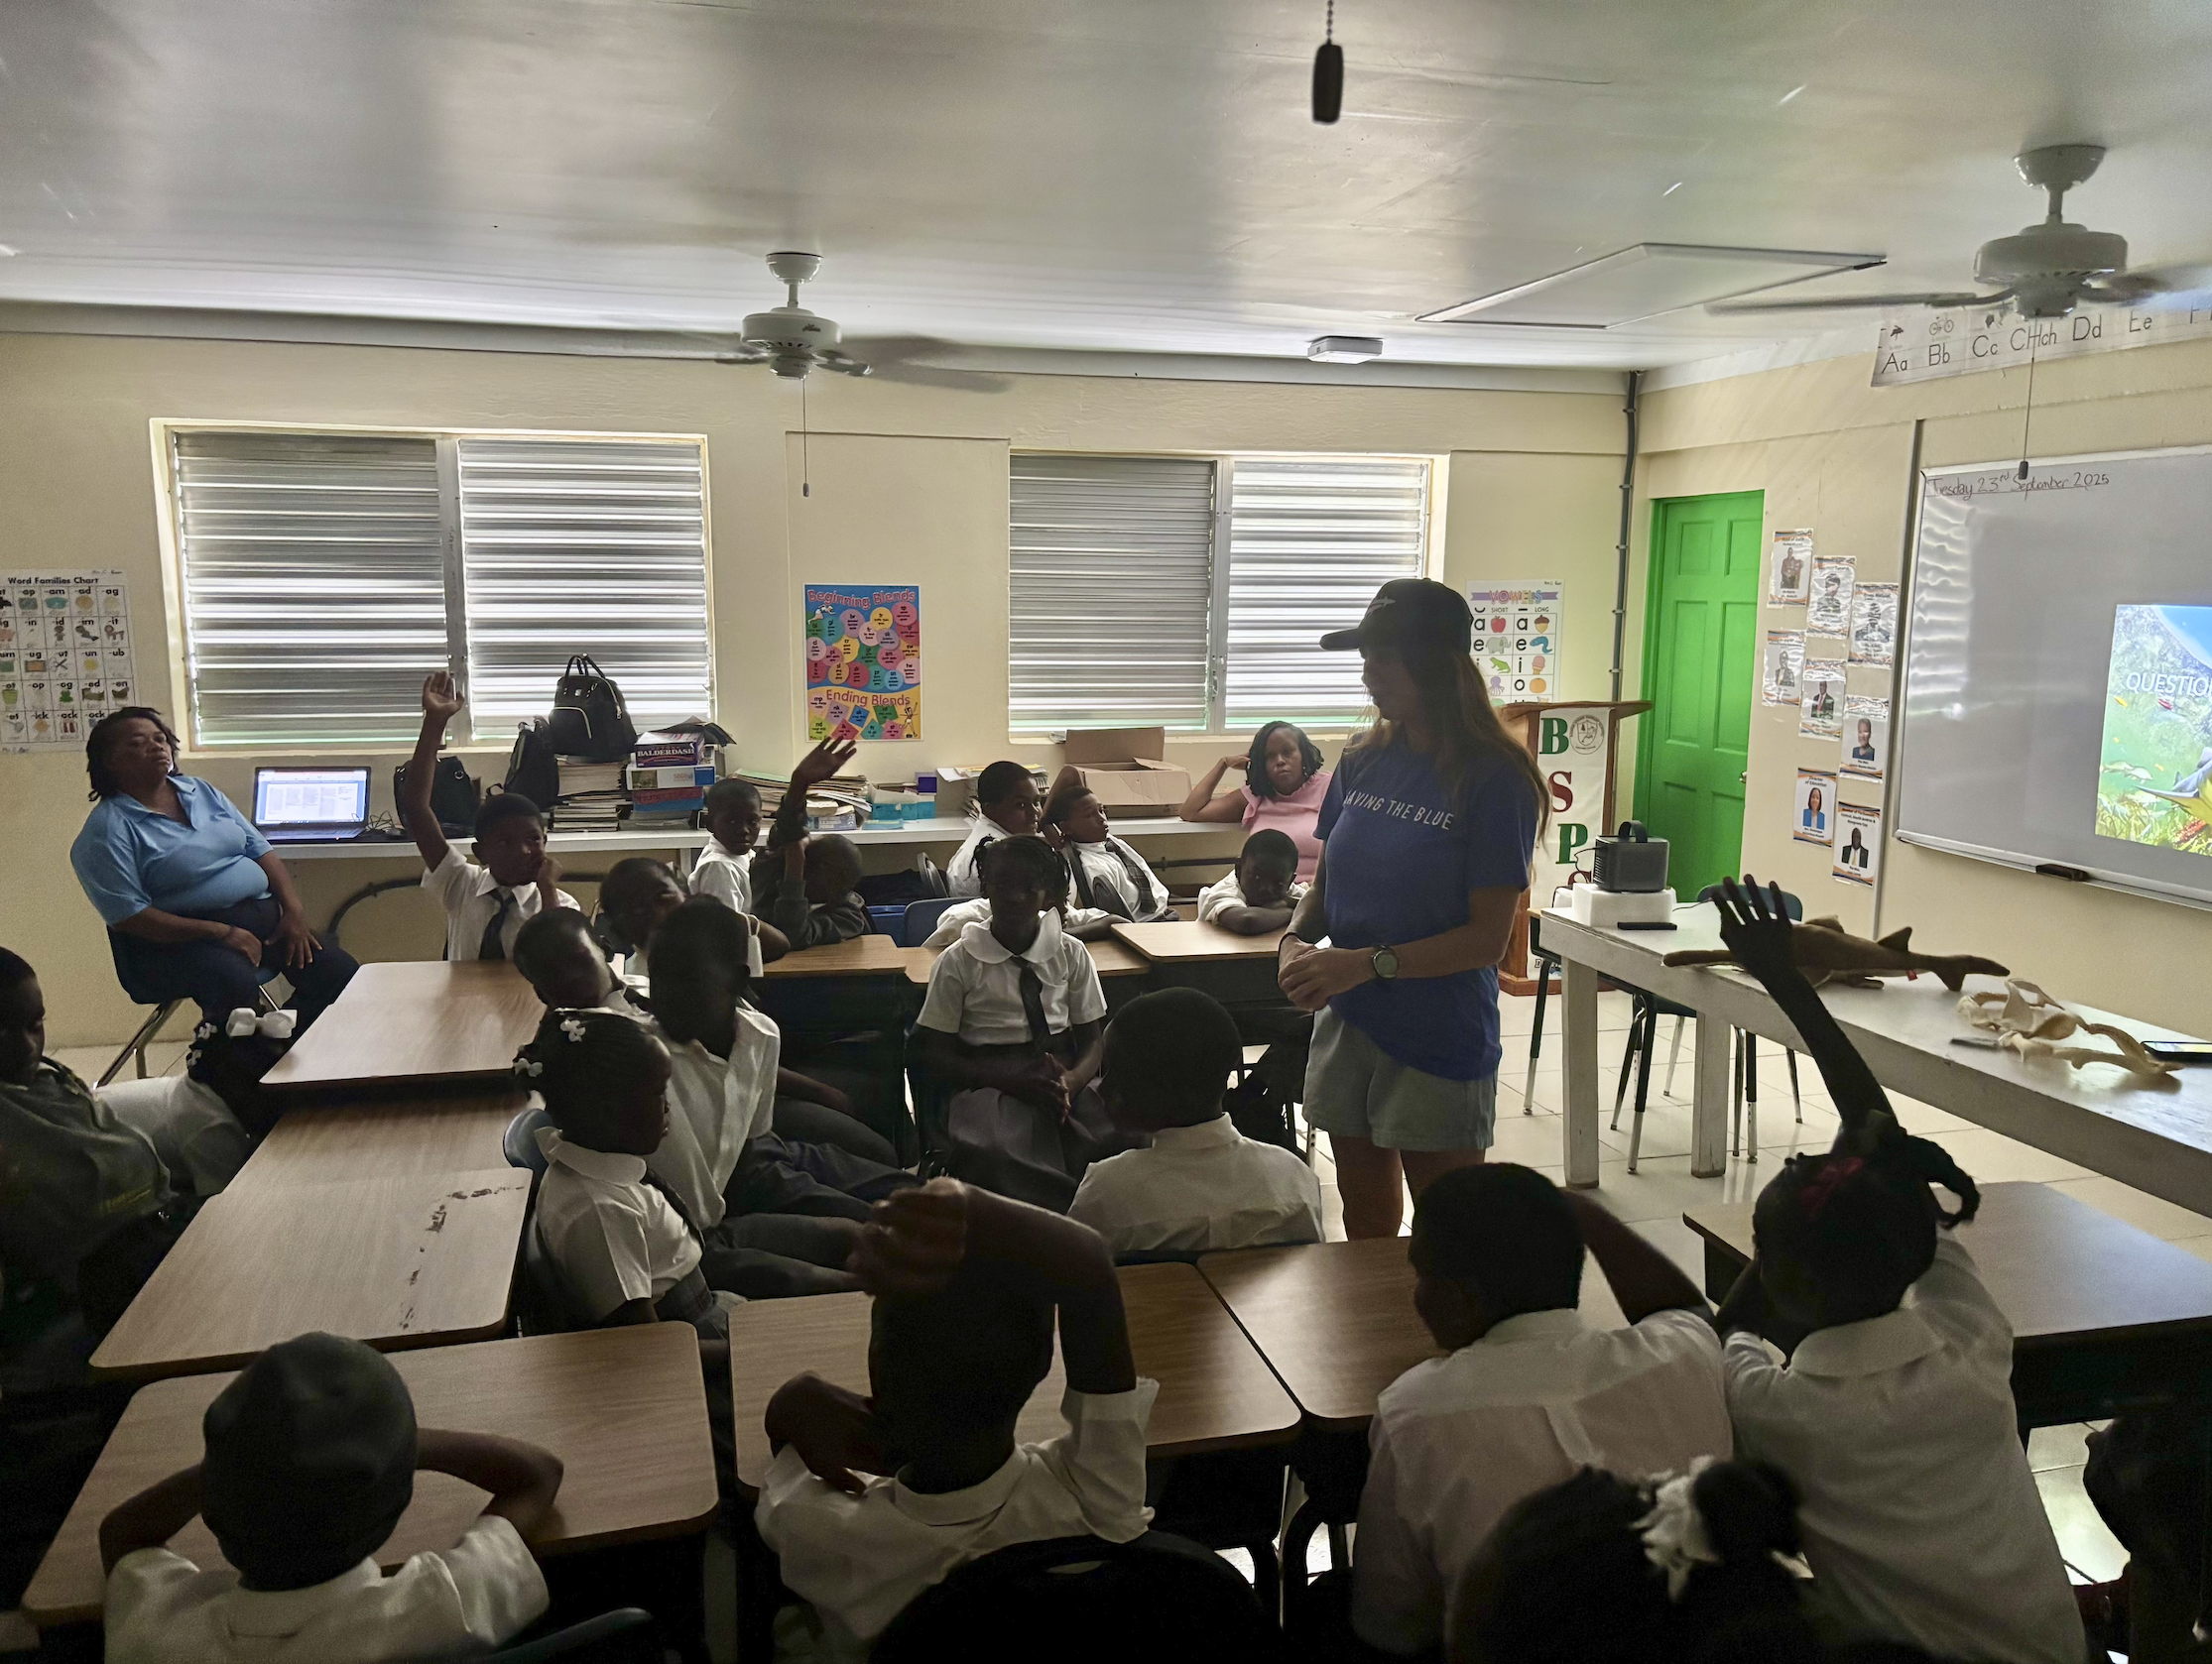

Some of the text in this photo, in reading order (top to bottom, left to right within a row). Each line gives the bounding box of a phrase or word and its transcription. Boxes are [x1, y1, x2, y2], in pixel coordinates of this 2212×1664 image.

[1882, 352, 1907, 374] Aa
[1928, 343, 1950, 366] Bb
[1972, 335, 1999, 358] Cc
[2010, 321, 2057, 351] CHch
[2072, 314, 2102, 341] Dd
[2129, 309, 2152, 332] Ee
[1927, 478, 1973, 501] Tuesday
[2012, 473, 2068, 501] September
[2073, 472, 2110, 489] 2025
[807, 588, 916, 610] Beginning Blends
[1489, 590, 1542, 604] VOWELS
[1474, 618, 1528, 631] a a
[109, 648, 125, 656] -ub
[1473, 639, 1527, 652] e e
[1519, 656, 1523, 673] i
[1514, 679, 1526, 691] o
[2126, 672, 2212, 696] QUESTIO
[826, 689, 911, 707] Ending Blends
[637, 748, 695, 757] BALDERDASH
[1387, 800, 1413, 819] THE
[1413, 806, 1454, 830] BLUE
